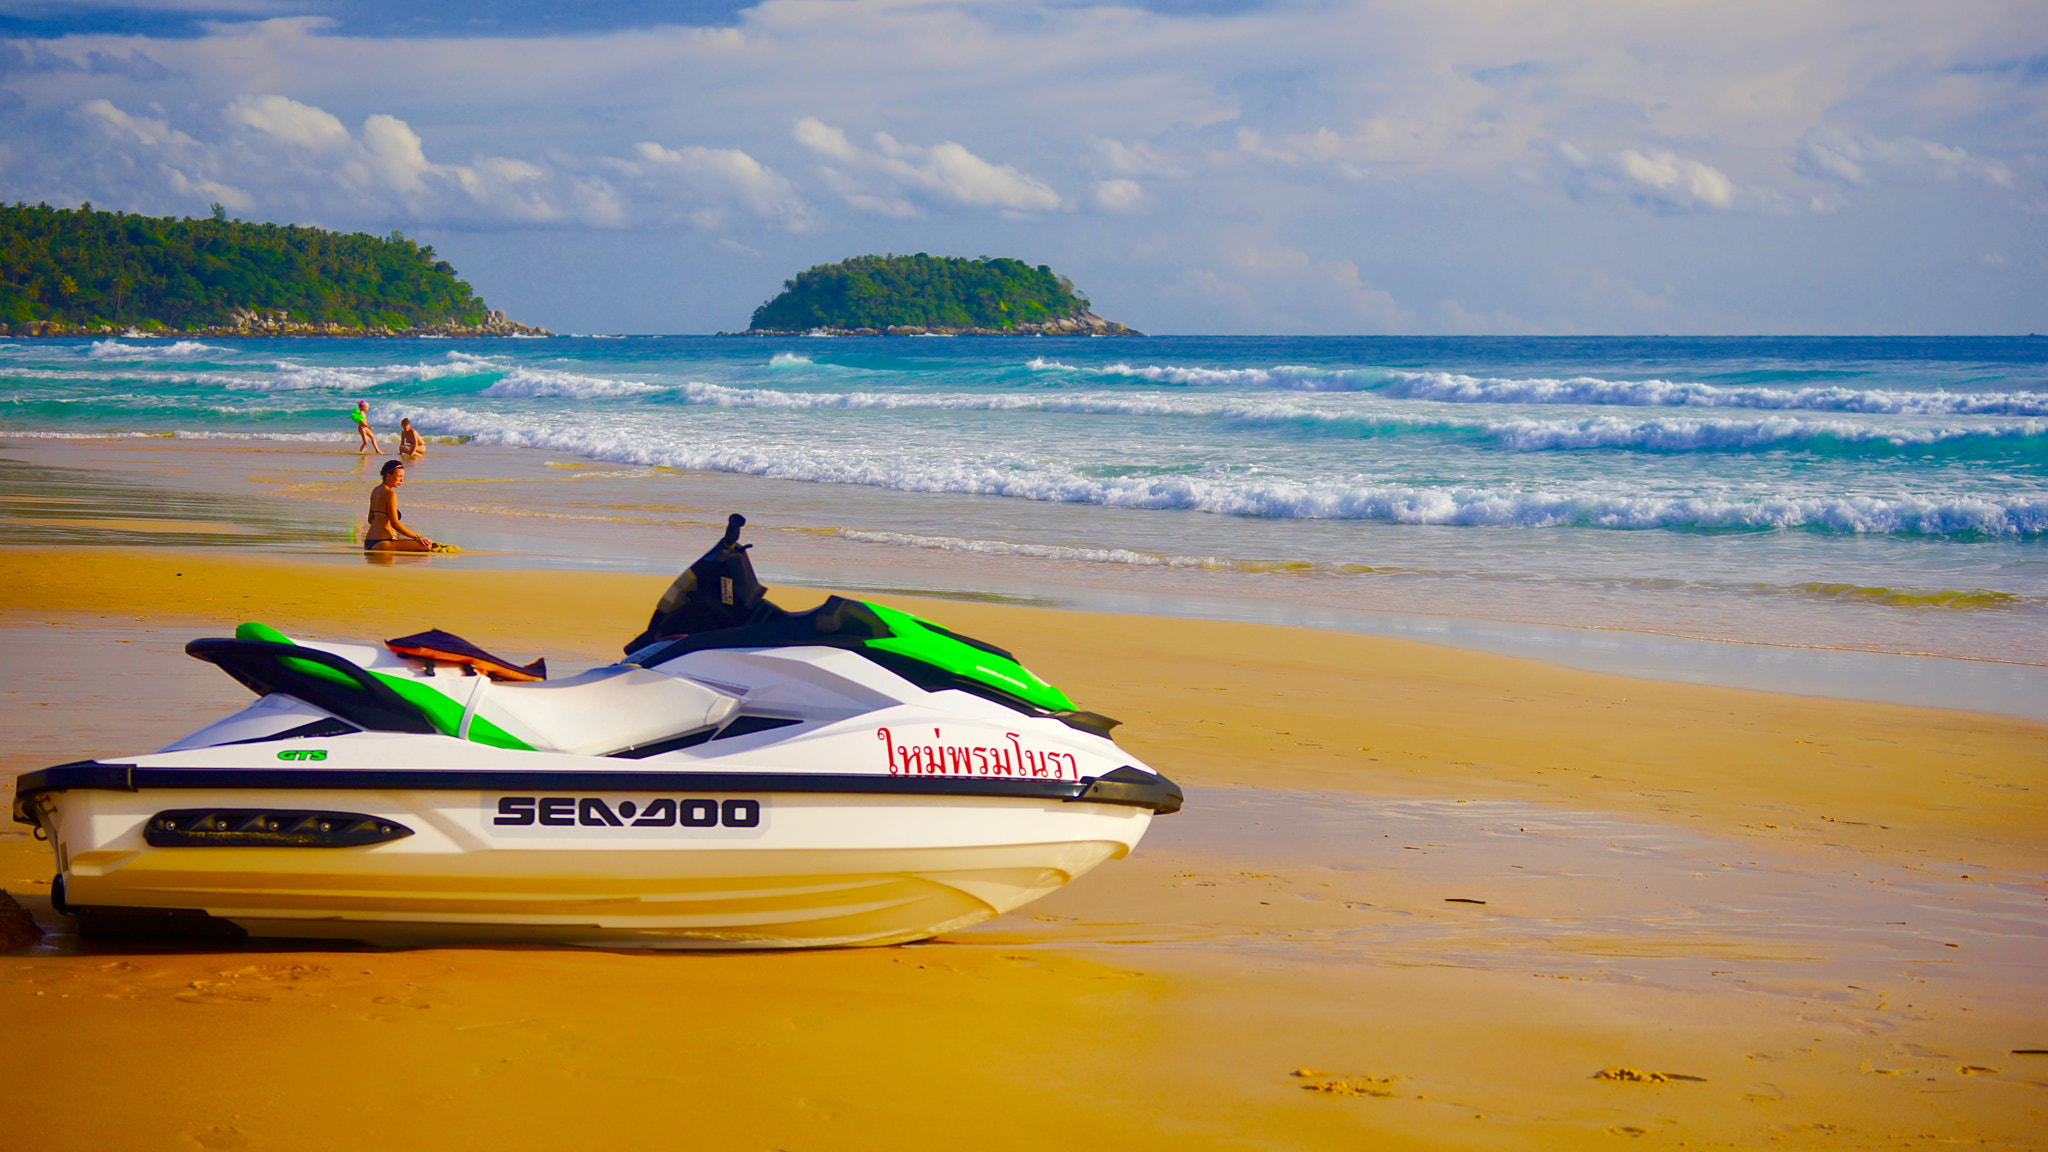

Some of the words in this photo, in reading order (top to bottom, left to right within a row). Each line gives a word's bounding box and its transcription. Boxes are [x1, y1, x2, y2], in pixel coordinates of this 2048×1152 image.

[277, 749, 328, 761] GTS
[877, 727, 1079, 780] ใหม่พรมโนรา
